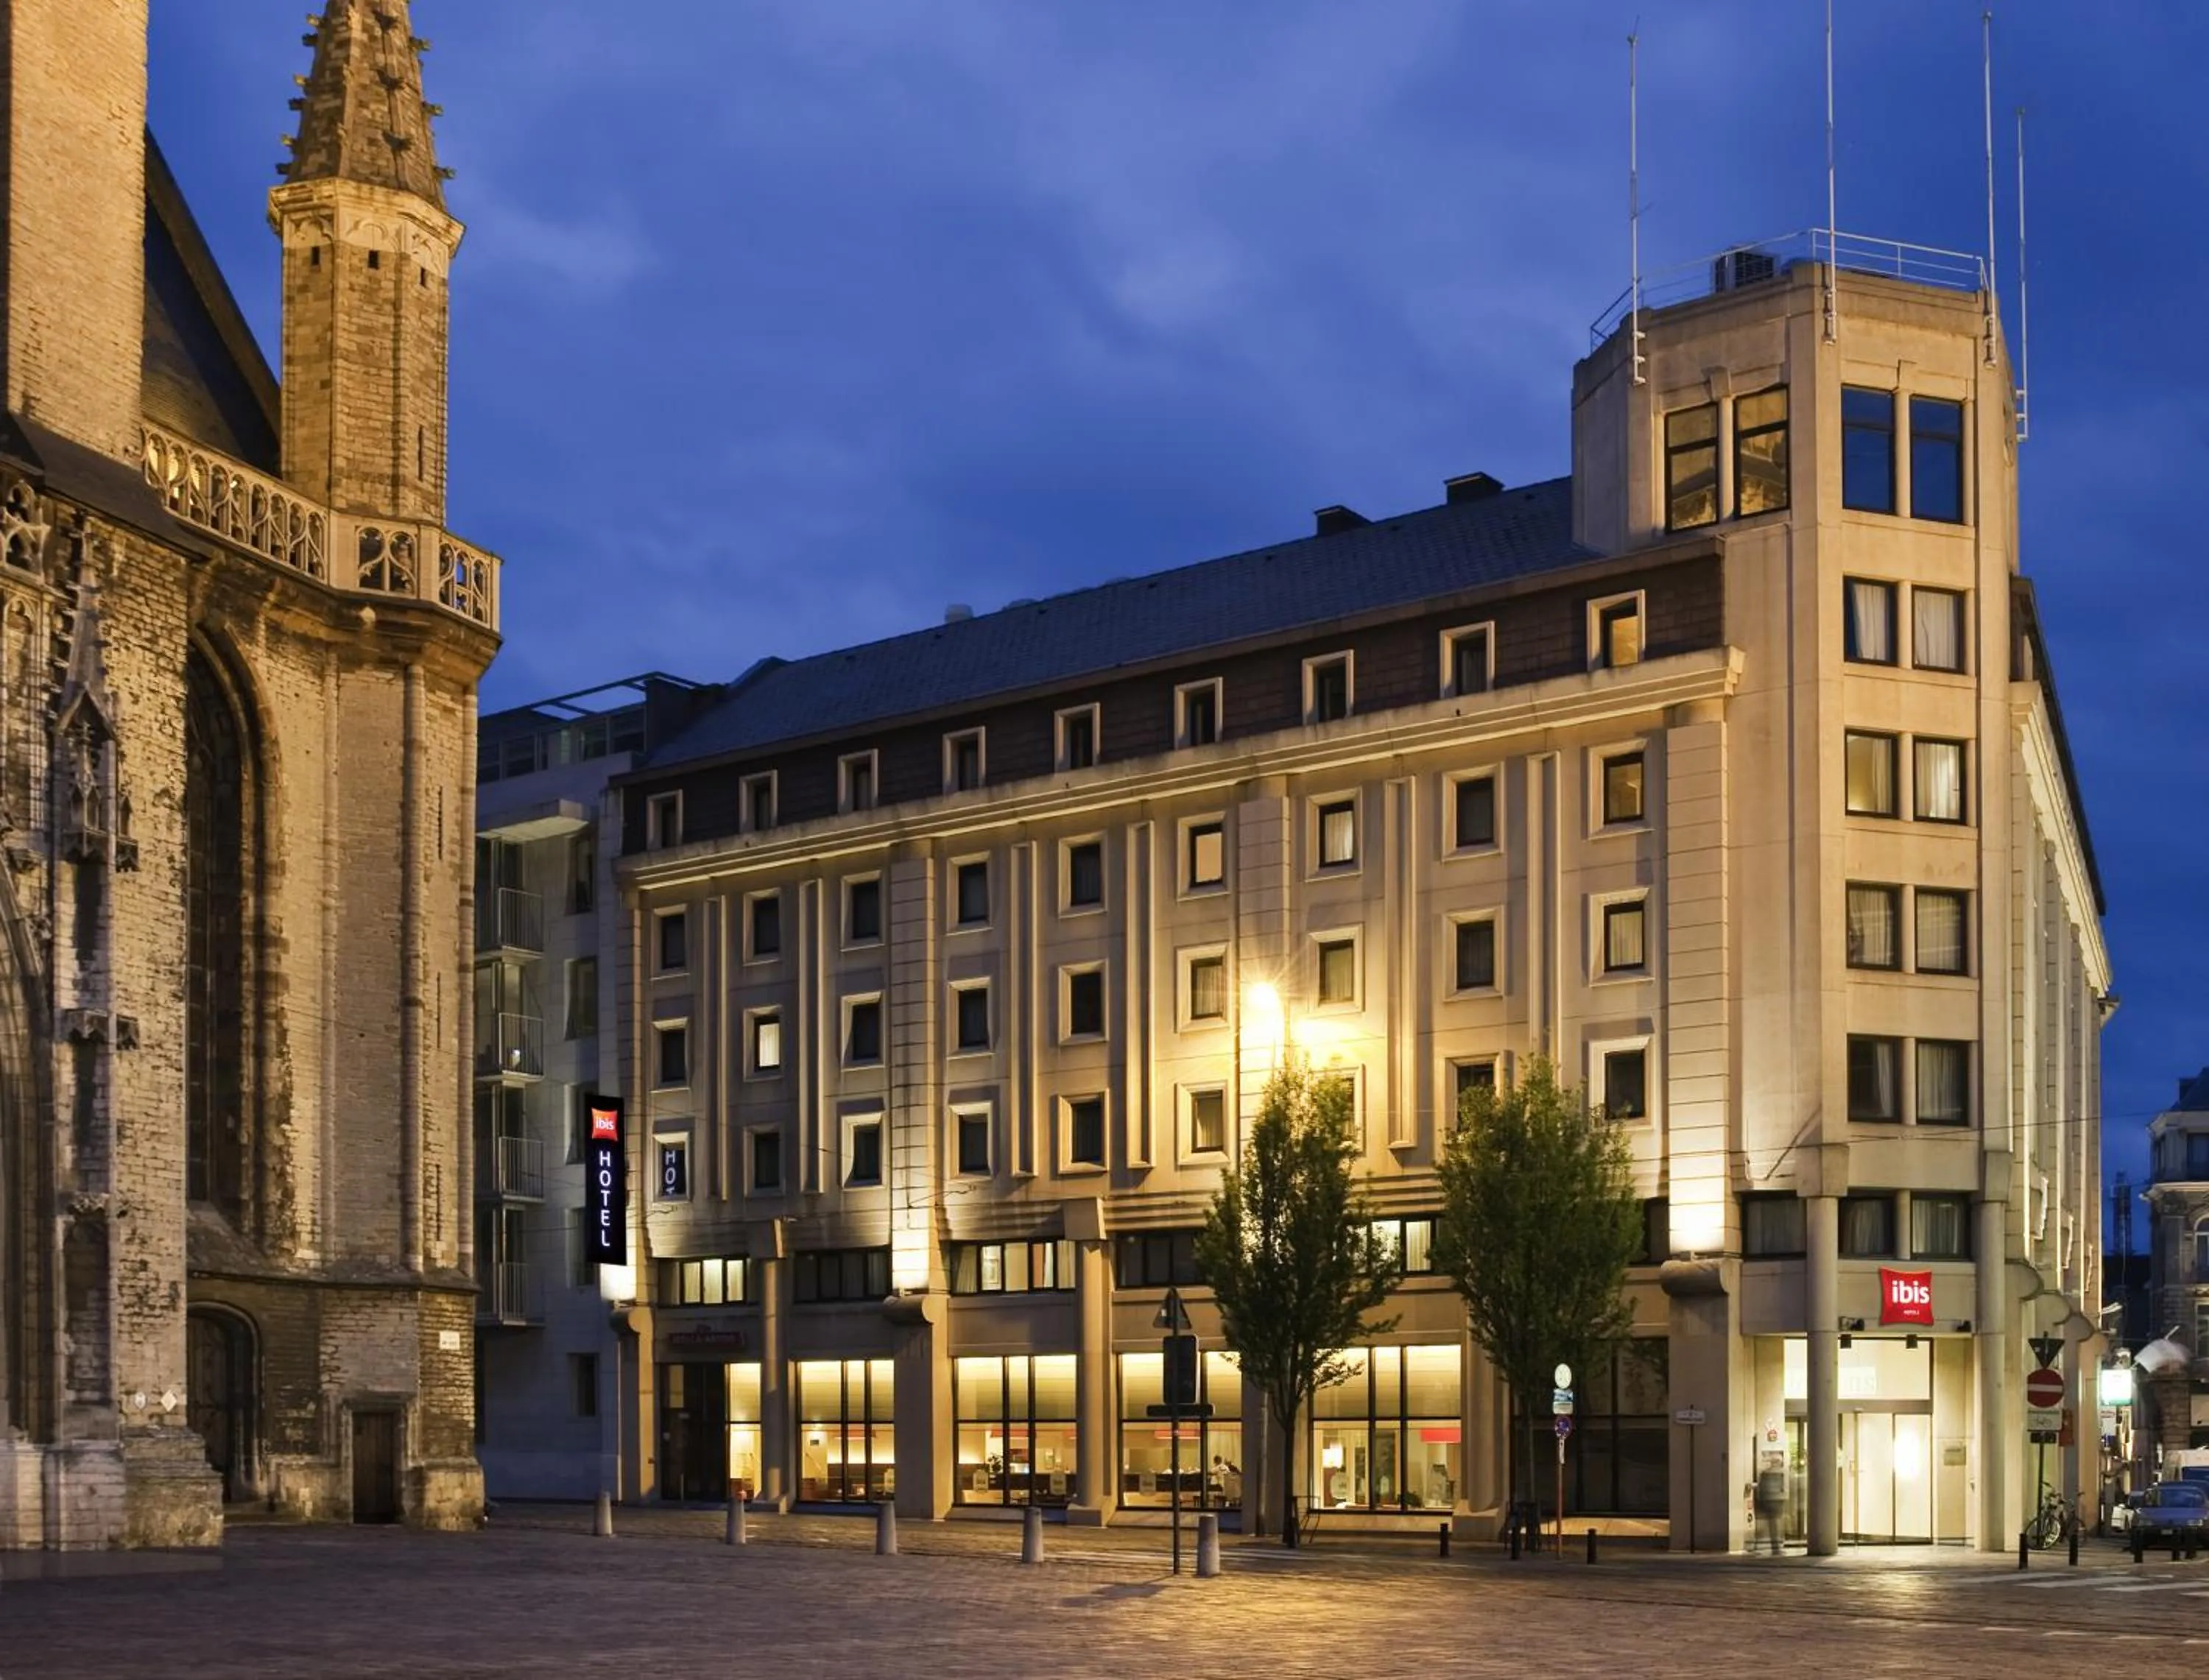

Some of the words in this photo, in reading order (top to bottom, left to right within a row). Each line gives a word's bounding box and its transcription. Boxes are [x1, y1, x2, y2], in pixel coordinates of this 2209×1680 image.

[595, 1115, 615, 1130] ibis
[599, 1150, 612, 1247] HOTEL
[1892, 1280, 1930, 1304] ibis
